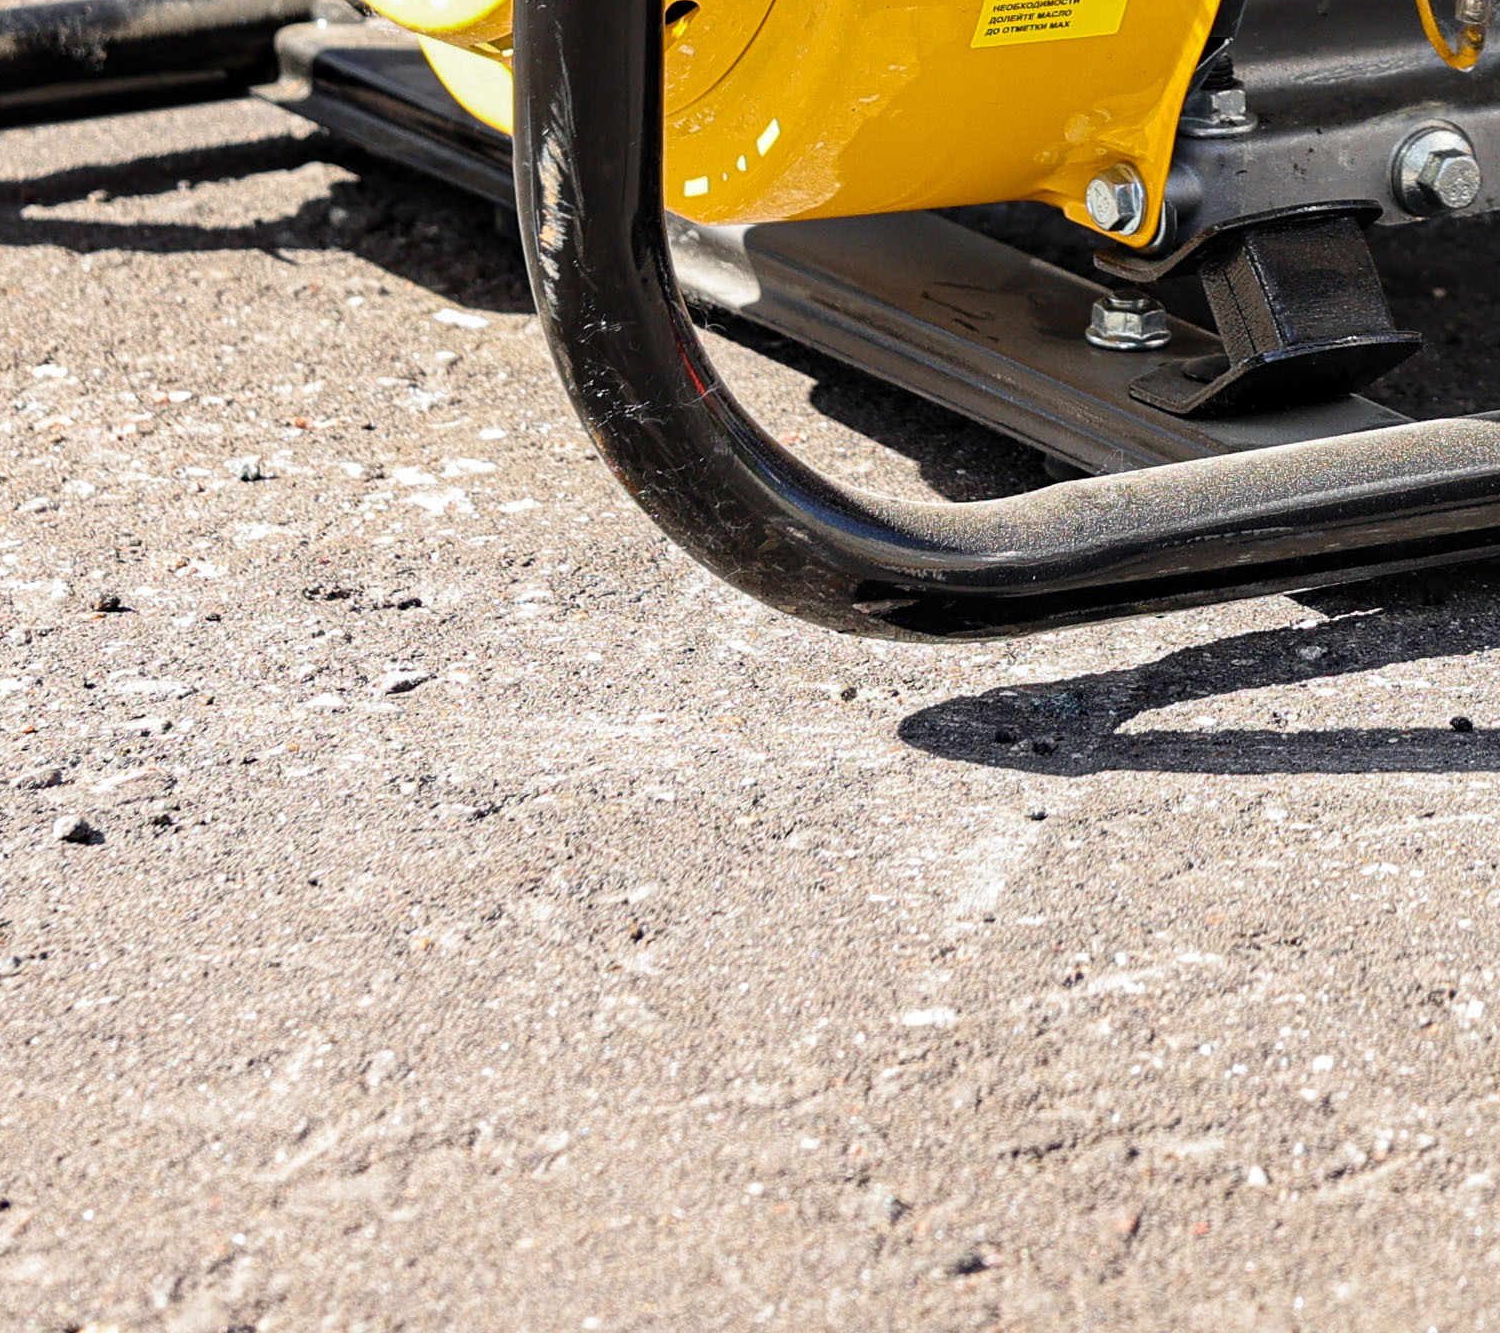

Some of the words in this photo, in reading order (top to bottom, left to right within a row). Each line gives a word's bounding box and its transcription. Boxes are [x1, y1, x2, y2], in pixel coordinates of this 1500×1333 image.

[988, 12, 1034, 25] ДОЛЕЙТЕ
[1037, 9, 1072, 19] МАСЛО
[984, 27, 1000, 36] ДО
[1002, 24, 1047, 34] ОТМЕТКИ
